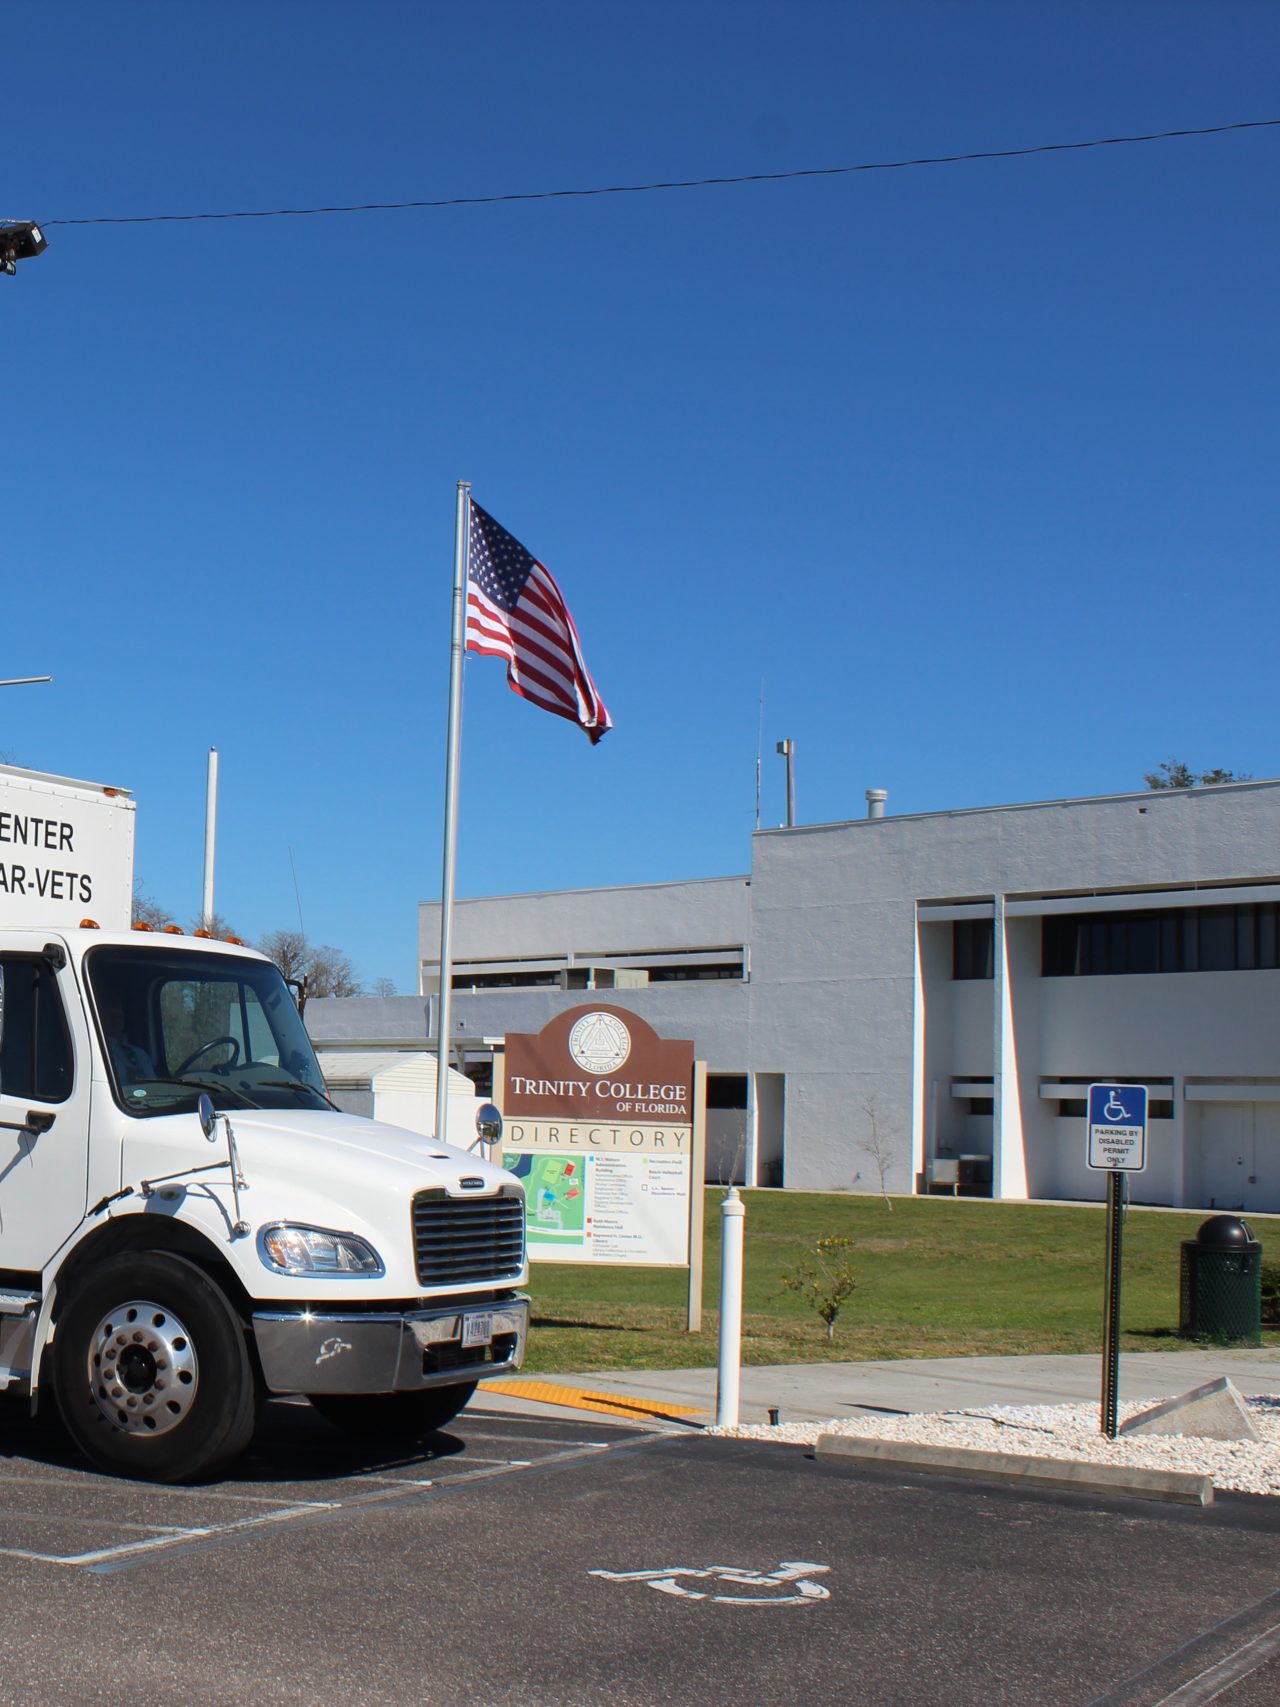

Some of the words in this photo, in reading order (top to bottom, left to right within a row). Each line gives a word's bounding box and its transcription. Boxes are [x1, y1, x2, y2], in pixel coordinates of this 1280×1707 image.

[510, 1076, 591, 1097] TRINITY
[595, 1080, 687, 1101] COLLEGE
[616, 1101, 633, 1113] OF
[635, 1103, 687, 1115] FLORIDA
[510, 1125, 685, 1148] DIRECTORY
[1095, 1128, 1127, 1136] PARKING
[1098, 1138, 1135, 1146] DISABLED
